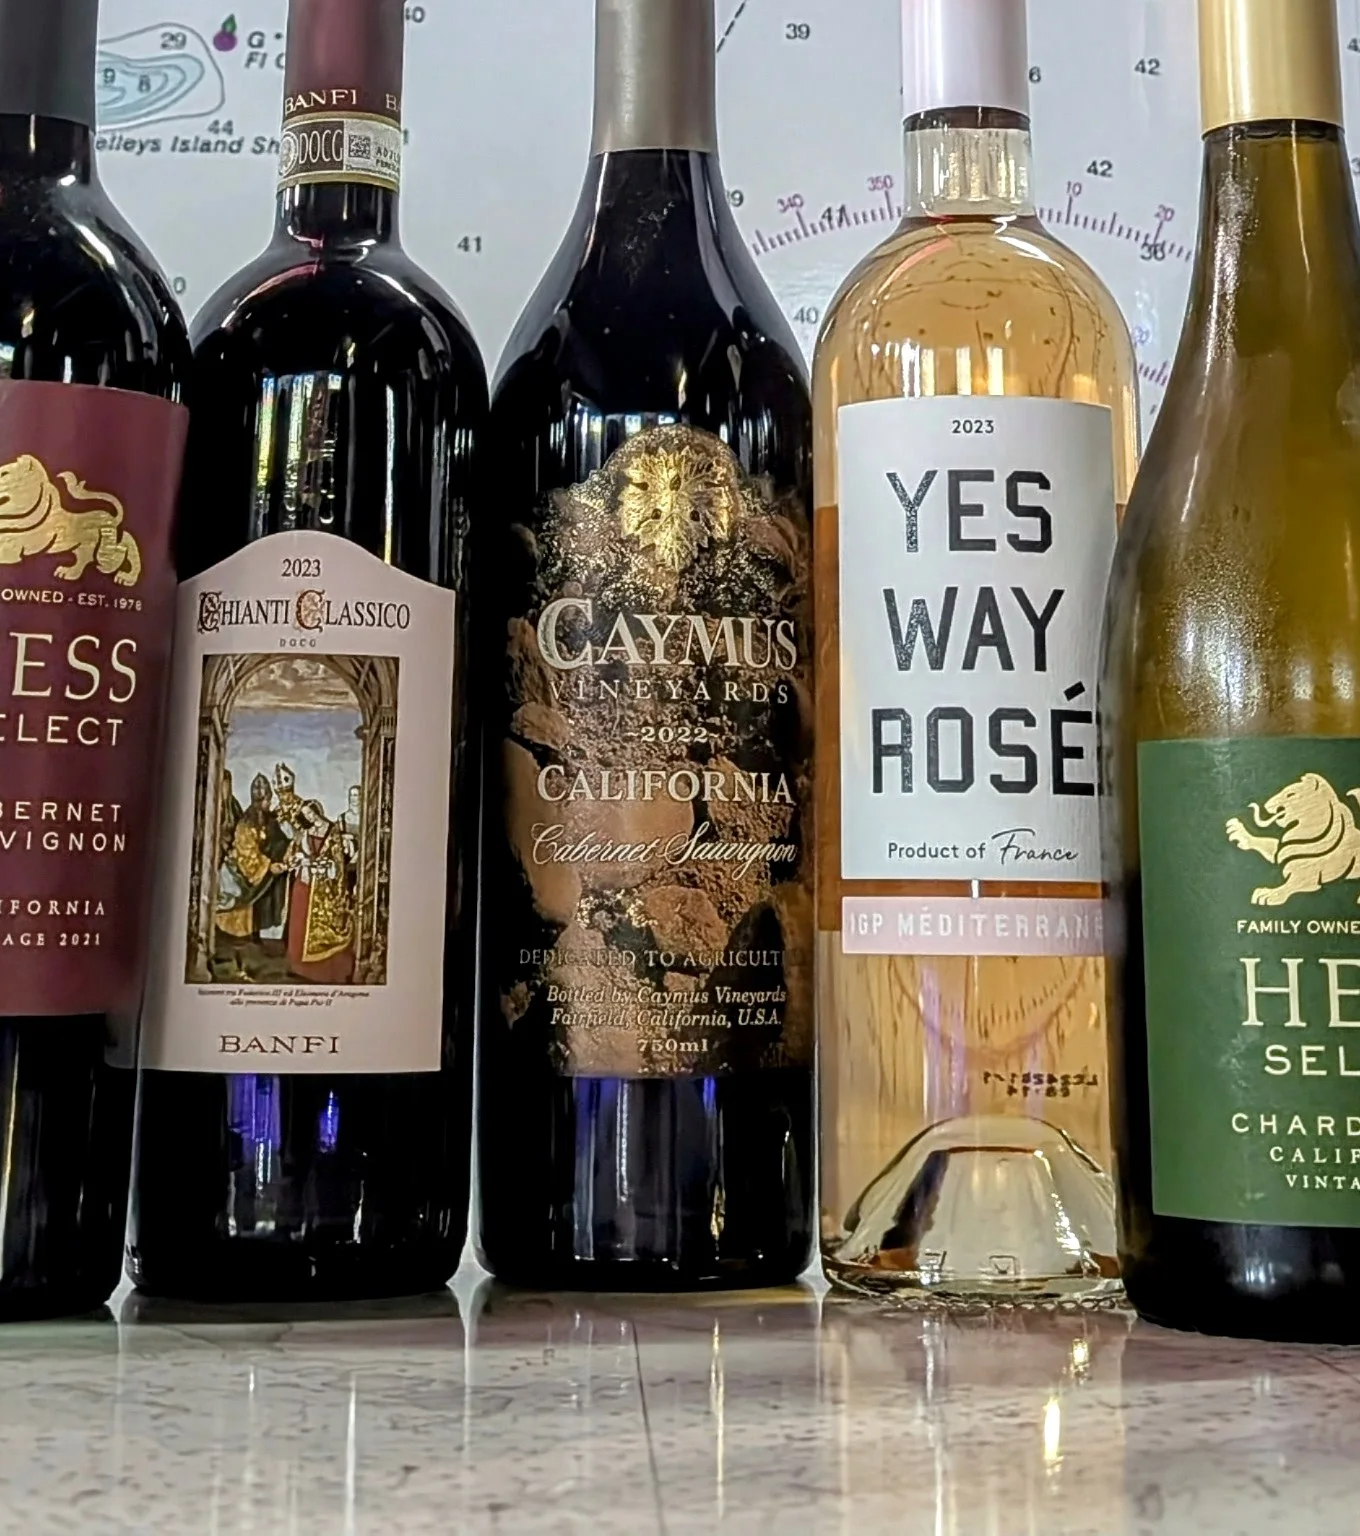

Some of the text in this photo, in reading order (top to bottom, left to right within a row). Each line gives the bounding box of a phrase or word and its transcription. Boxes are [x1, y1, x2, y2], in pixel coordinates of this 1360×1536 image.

[284, 89, 357, 115] BANFI
[93, 136, 245, 157] elleys Island
[298, 129, 343, 164] DOCG
[1086, 159, 1114, 177] 42
[952, 419, 995, 435] 2023
[886, 469, 1053, 555] YES
[281, 558, 322, 579] 2023
[1, 587, 64, 605] OWNED
[78, 593, 111, 608] EST.
[114, 596, 143, 612] 1978
[196, 588, 411, 635] CHIANTI CLASSICO
[536, 597, 797, 672] CAYMUS
[882, 586, 1065, 672] WAY
[550, 679, 789, 705] VINEYARDS
[871, 681, 1095, 797] ROSÉ
[536, 763, 796, 805] CALIFORNIA
[532, 820, 797, 880] Cabernet Sauvignon
[887, 827, 1079, 863] Product of France
[58, 932, 101, 947] 2021
[1237, 920, 1301, 935] FAMILY
[519, 948, 636, 965] DEDICATED
[643, 950, 675, 967] TO
[547, 985, 786, 1006] Bottled by Caymus Vineyards
[637, 1008, 732, 1029] California,
[738, 1009, 782, 1026] U.S.A.
[219, 1035, 340, 1054] BANFI
[638, 1039, 708, 1052] 750ml
